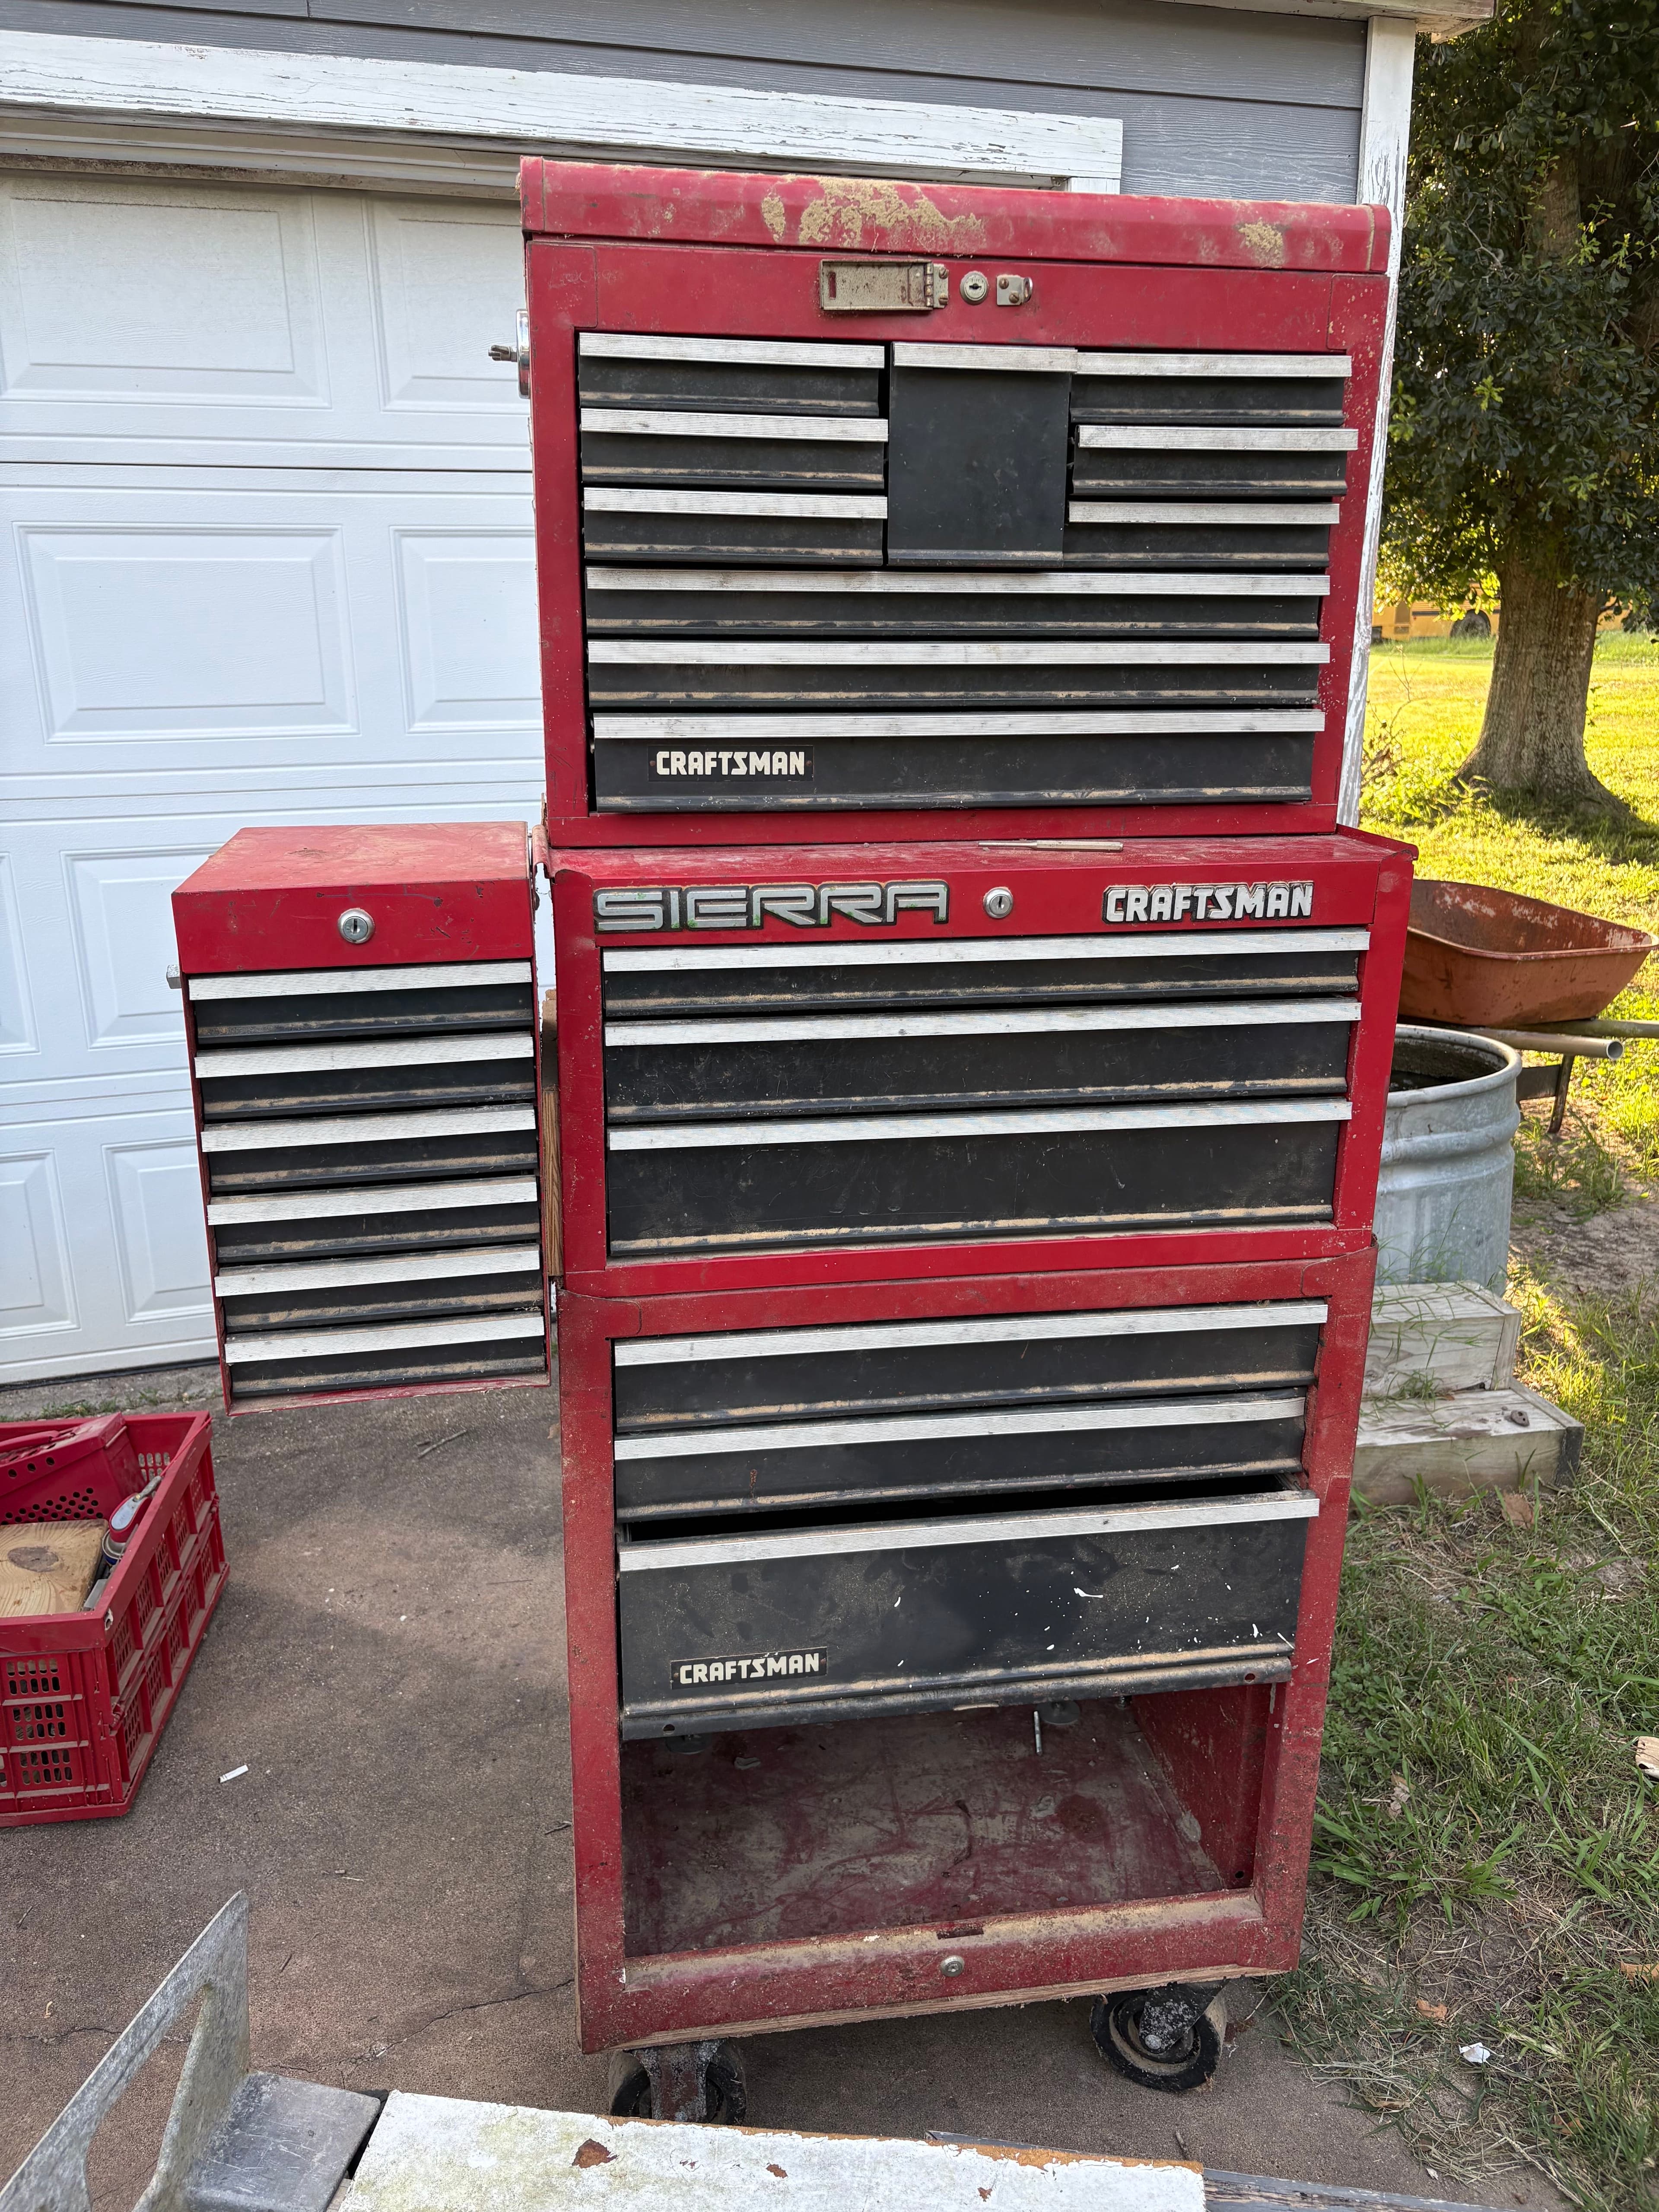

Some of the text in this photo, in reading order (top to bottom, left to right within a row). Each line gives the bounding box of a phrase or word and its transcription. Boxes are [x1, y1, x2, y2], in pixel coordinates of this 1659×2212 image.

[656, 750, 805, 775] CRAFTSMAN
[595, 881, 949, 931] SIERRA
[1104, 881, 1314, 924] CRAFTSMAN
[679, 1652, 820, 1685] CRAFTSMAN
